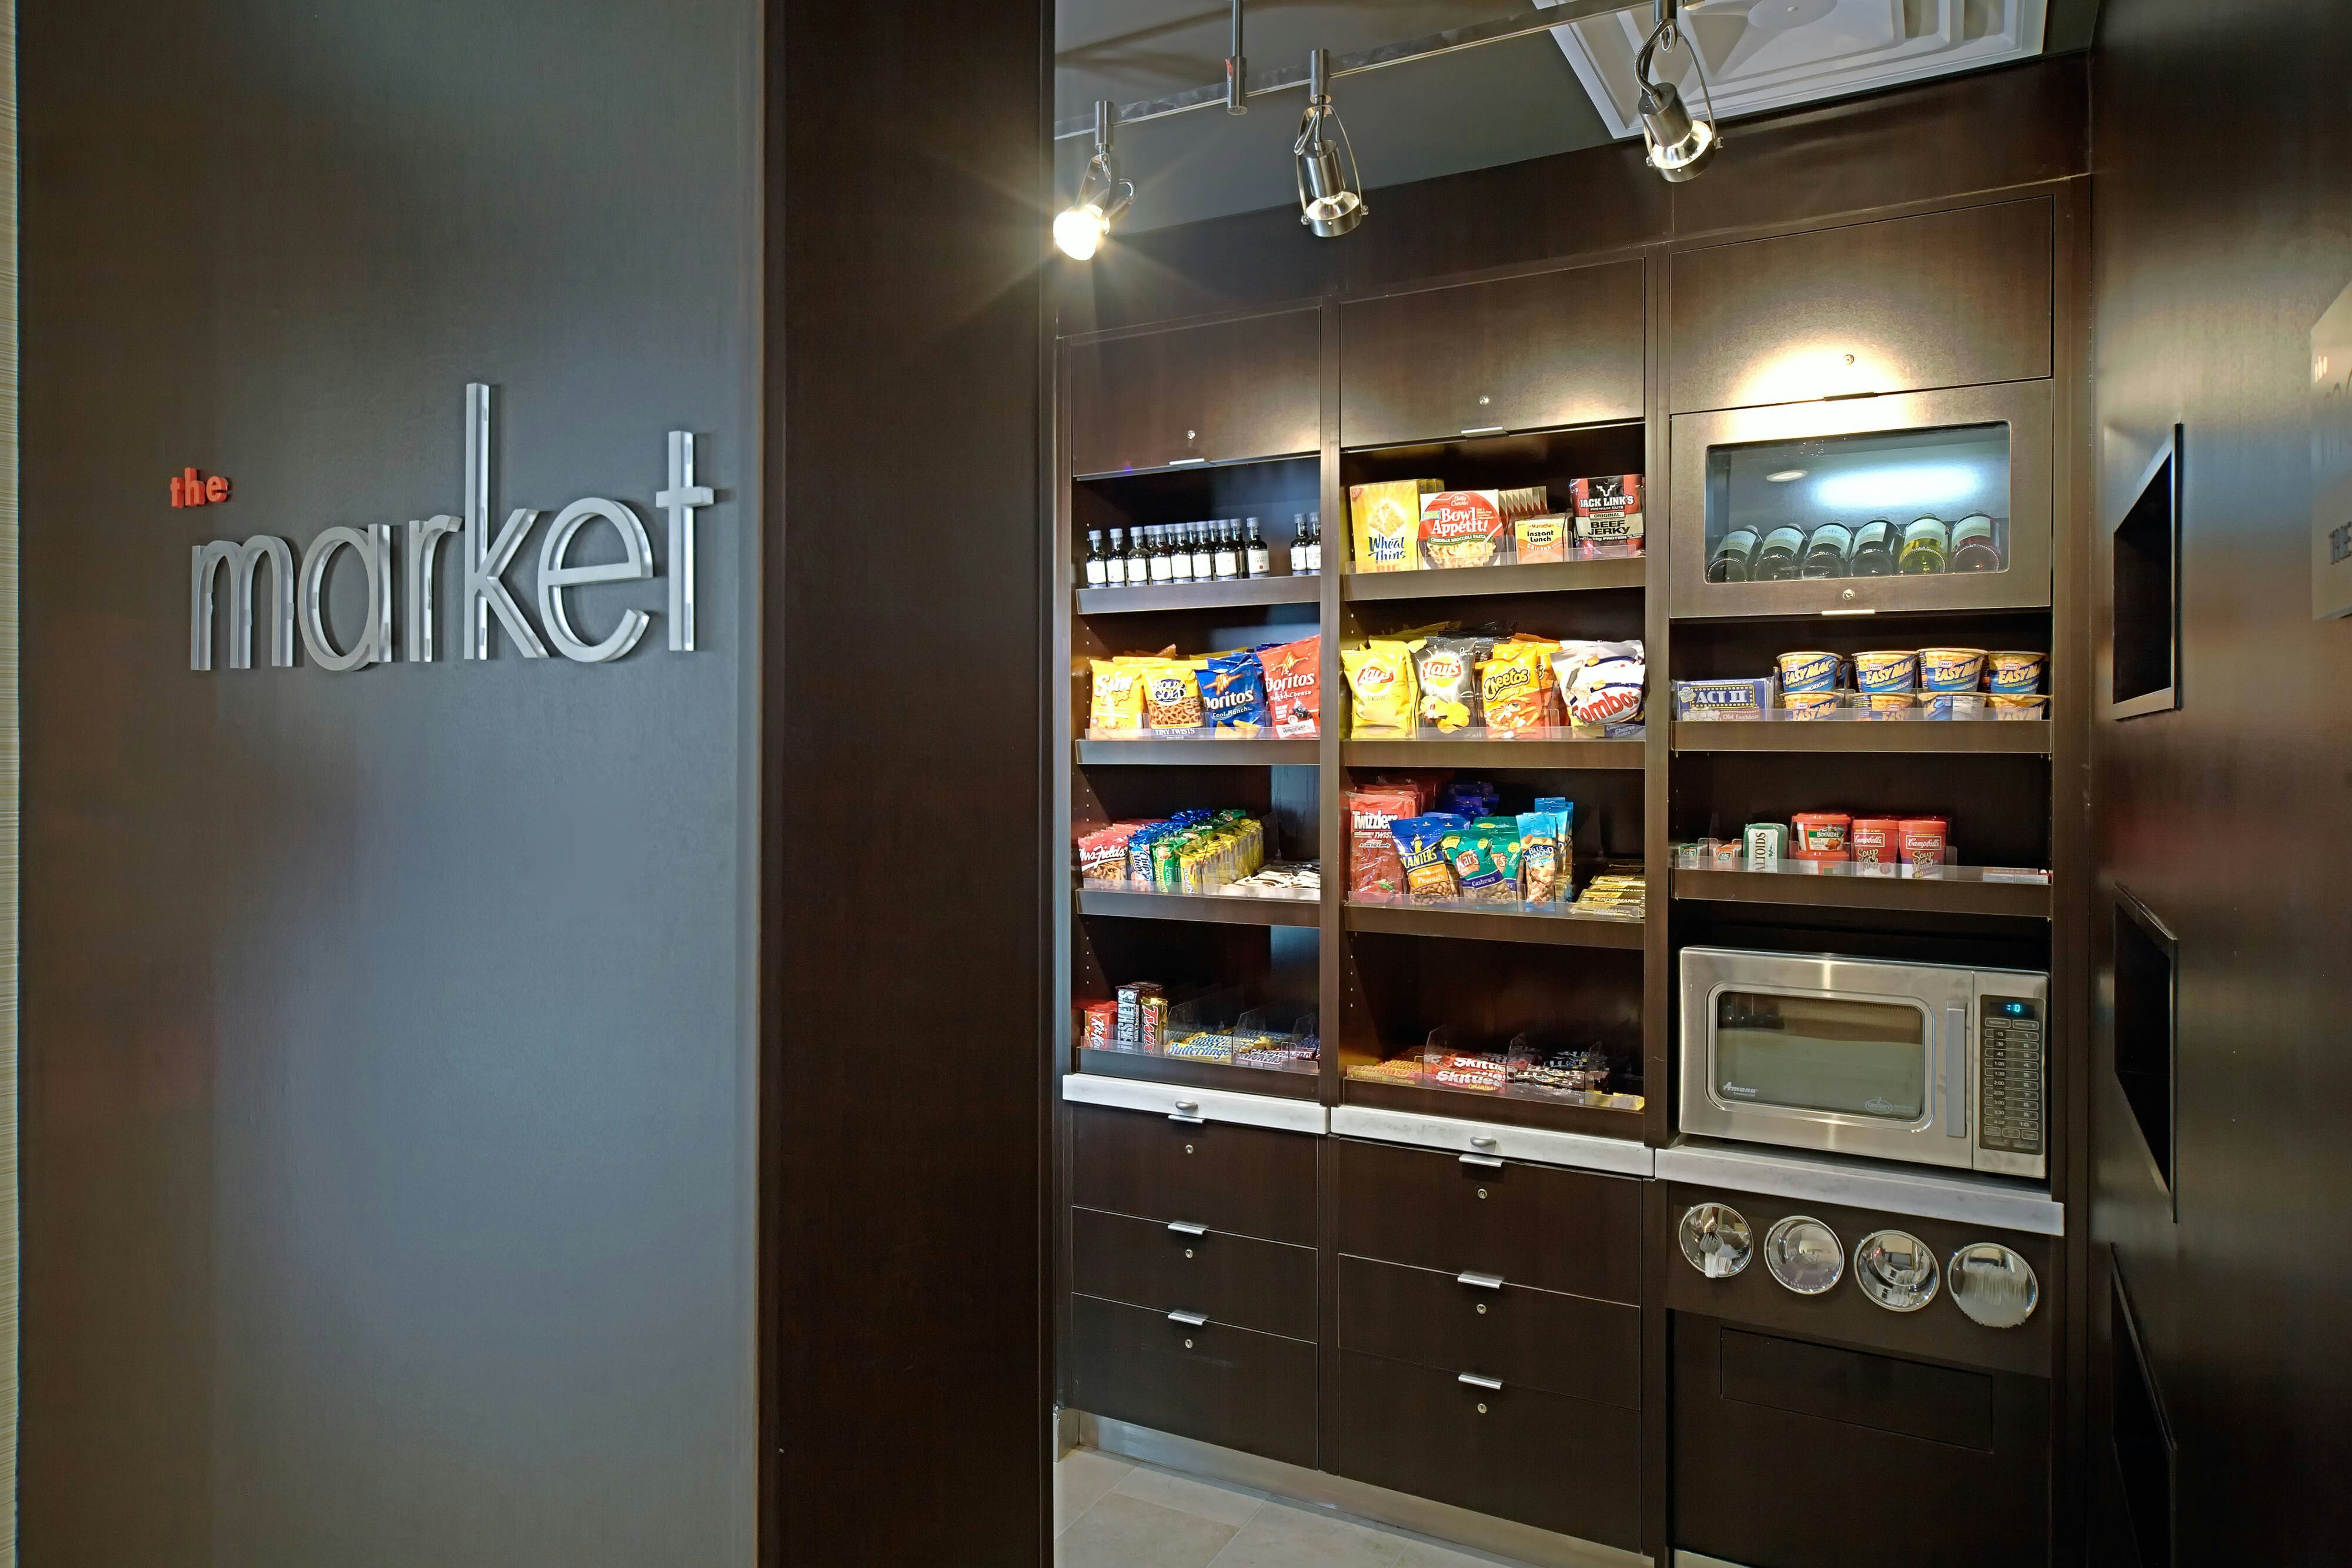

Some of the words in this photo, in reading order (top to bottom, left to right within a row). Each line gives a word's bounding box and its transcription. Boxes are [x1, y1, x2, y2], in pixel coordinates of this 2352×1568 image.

[170, 467, 230, 508] the
[1580, 498, 1602, 507] JACK
[1603, 494, 1634, 506] LINK'S
[1439, 506, 1476, 523] Bowl
[191, 382, 714, 671] market
[1588, 526, 1631, 536] JERKY
[1591, 520, 1625, 529] BEEF
[1368, 534, 1405, 552] Wheat
[1368, 549, 1406, 563] Thins
[1785, 667, 1808, 686] EASY
[1806, 659, 1833, 678] MAC
[1866, 667, 1893, 685] EASY
[1934, 666, 1965, 682] EASY
[1998, 668, 2029, 684] EASY
[1094, 674, 1133, 697] Sun
[1265, 673, 1315, 693] Doritos
[1484, 668, 1529, 700] Cheetos
[1288, 690, 1312, 699] Cheese
[1696, 691, 1727, 704] ACT
[1729, 690, 1748, 703] II
[1227, 706, 1248, 716] Ranch
[1793, 708, 1819, 721] EASY
[1855, 834, 1882, 845] Campbell's
[1908, 837, 1939, 848] Campbell's
[1524, 847, 1553, 861] DIAMOND
[1529, 846, 1545, 855] BLUE
[1755, 832, 1766, 872] ALTOIDS
[1857, 848, 1879, 861] Soup
[1912, 850, 1935, 864] Soup
[1140, 852, 1151, 877] Chips
[1456, 849, 1479, 869] Kar's
[1418, 874, 1444, 884] Peanuts
[1472, 877, 1495, 887] Cashews
[1143, 1004, 1159, 1054] Twix
[1167, 1042, 1232, 1059] Butterfinge
[1435, 1071, 1503, 1087] Skittles
[1723, 1081, 1756, 1094] Amana
